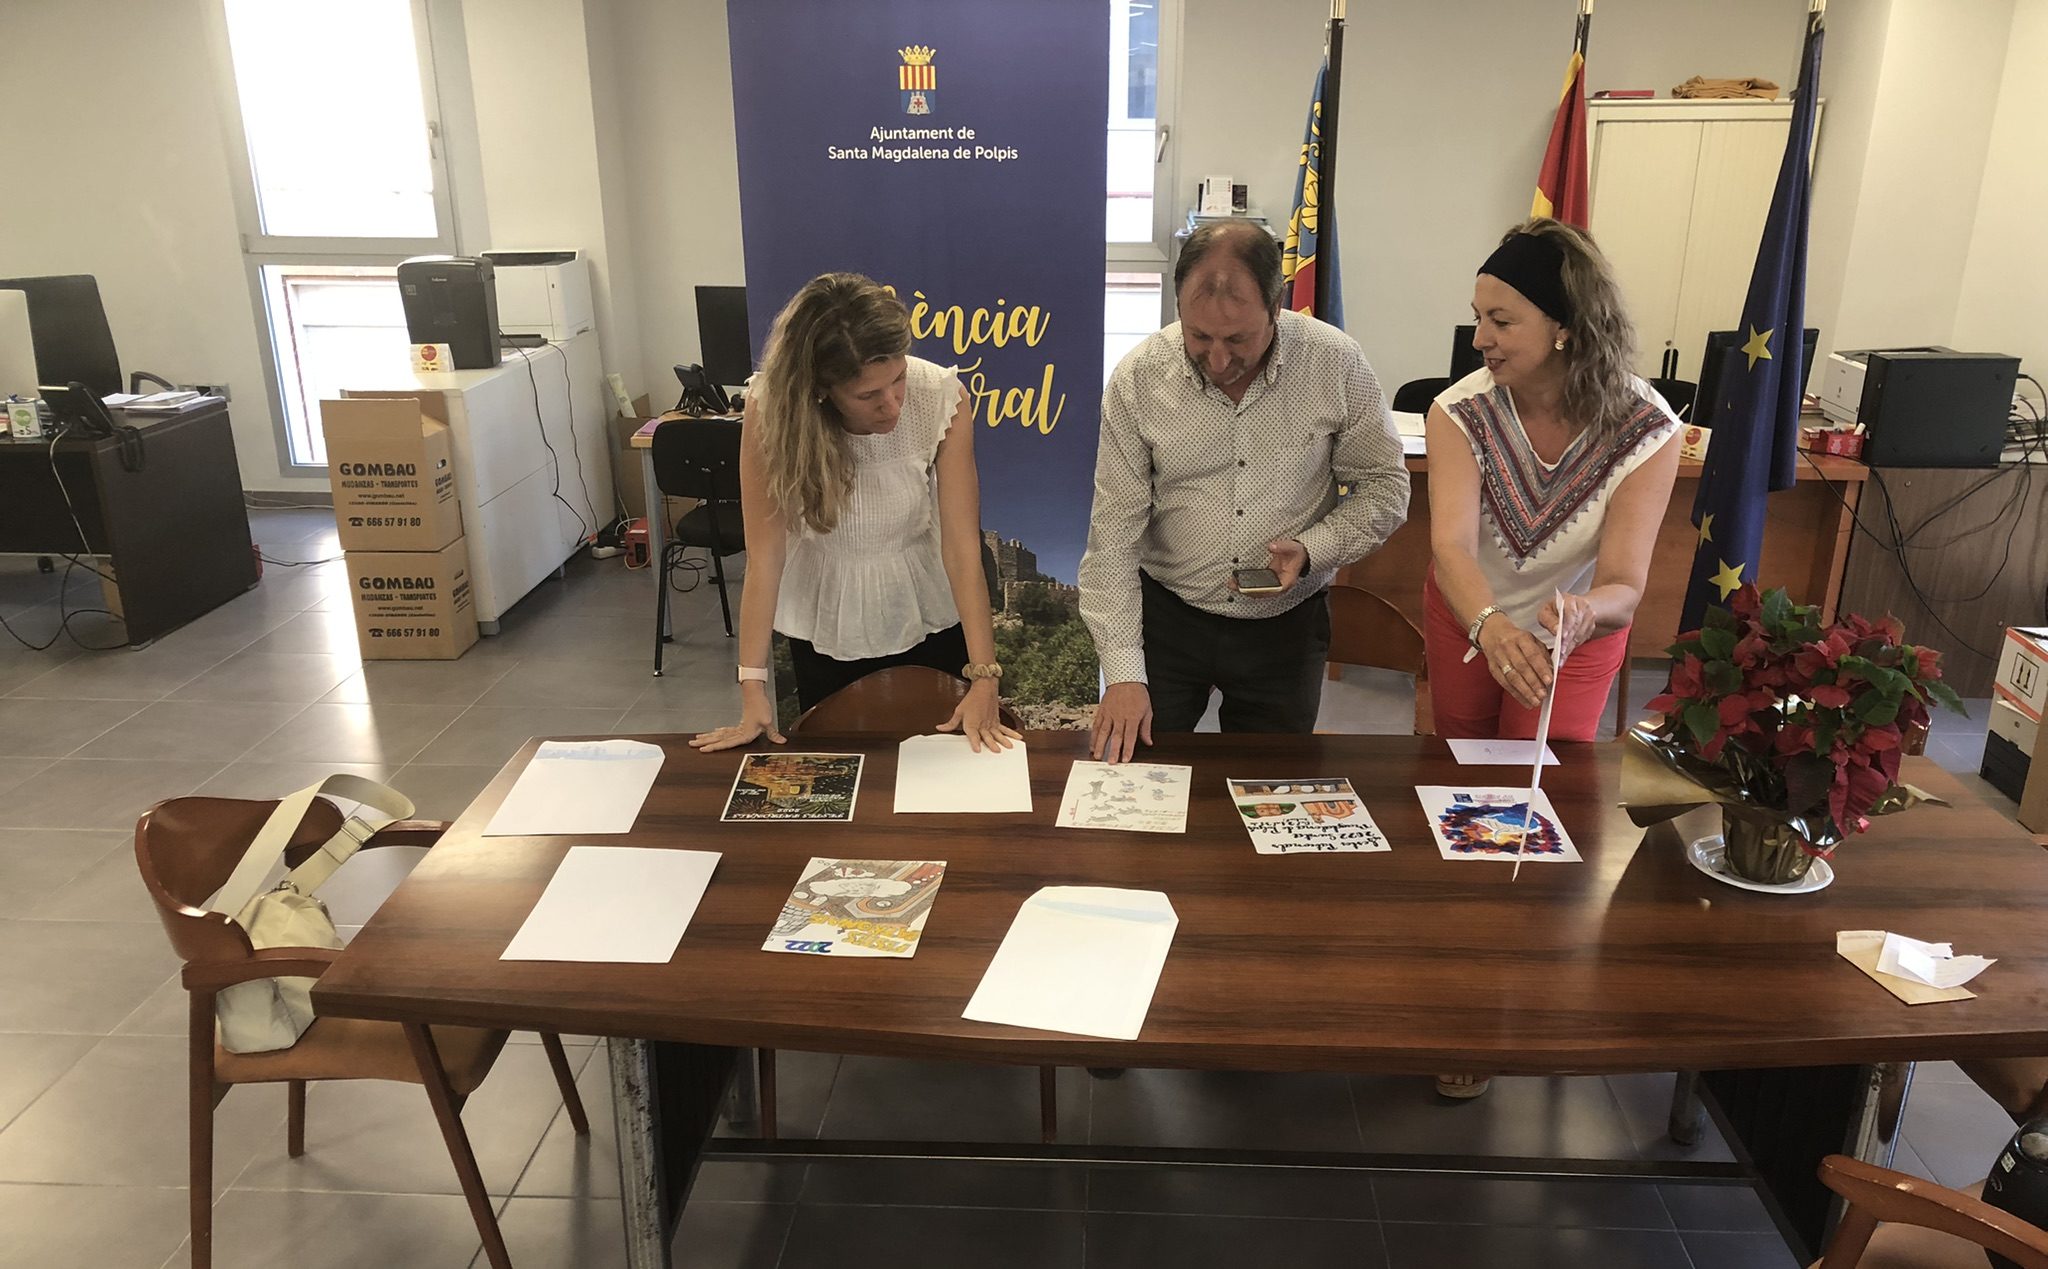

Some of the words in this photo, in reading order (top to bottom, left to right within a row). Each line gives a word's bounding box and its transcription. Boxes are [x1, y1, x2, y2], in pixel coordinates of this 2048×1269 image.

[870, 126, 954, 143] Ajuntament
[957, 126, 976, 140] de
[828, 146, 868, 160] Santa
[871, 146, 950, 162] Magdalena
[953, 146, 972, 159] de
[975, 146, 1018, 162] Polpis
[340, 463, 417, 476] GOMBAU
[342, 480, 375, 488] MUDANZAS
[381, 480, 419, 488] TRANSPORTES
[366, 517, 383, 526] 666
[384, 517, 395, 526] 57
[397, 517, 408, 526] 91
[410, 517, 421, 526] 80
[359, 577, 435, 590] GOMBAU
[386, 628, 402, 637] 666
[404, 628, 414, 637] 57
[416, 628, 427, 637] 91
[429, 628, 440, 637] 80
[785, 940, 833, 953] 2022
